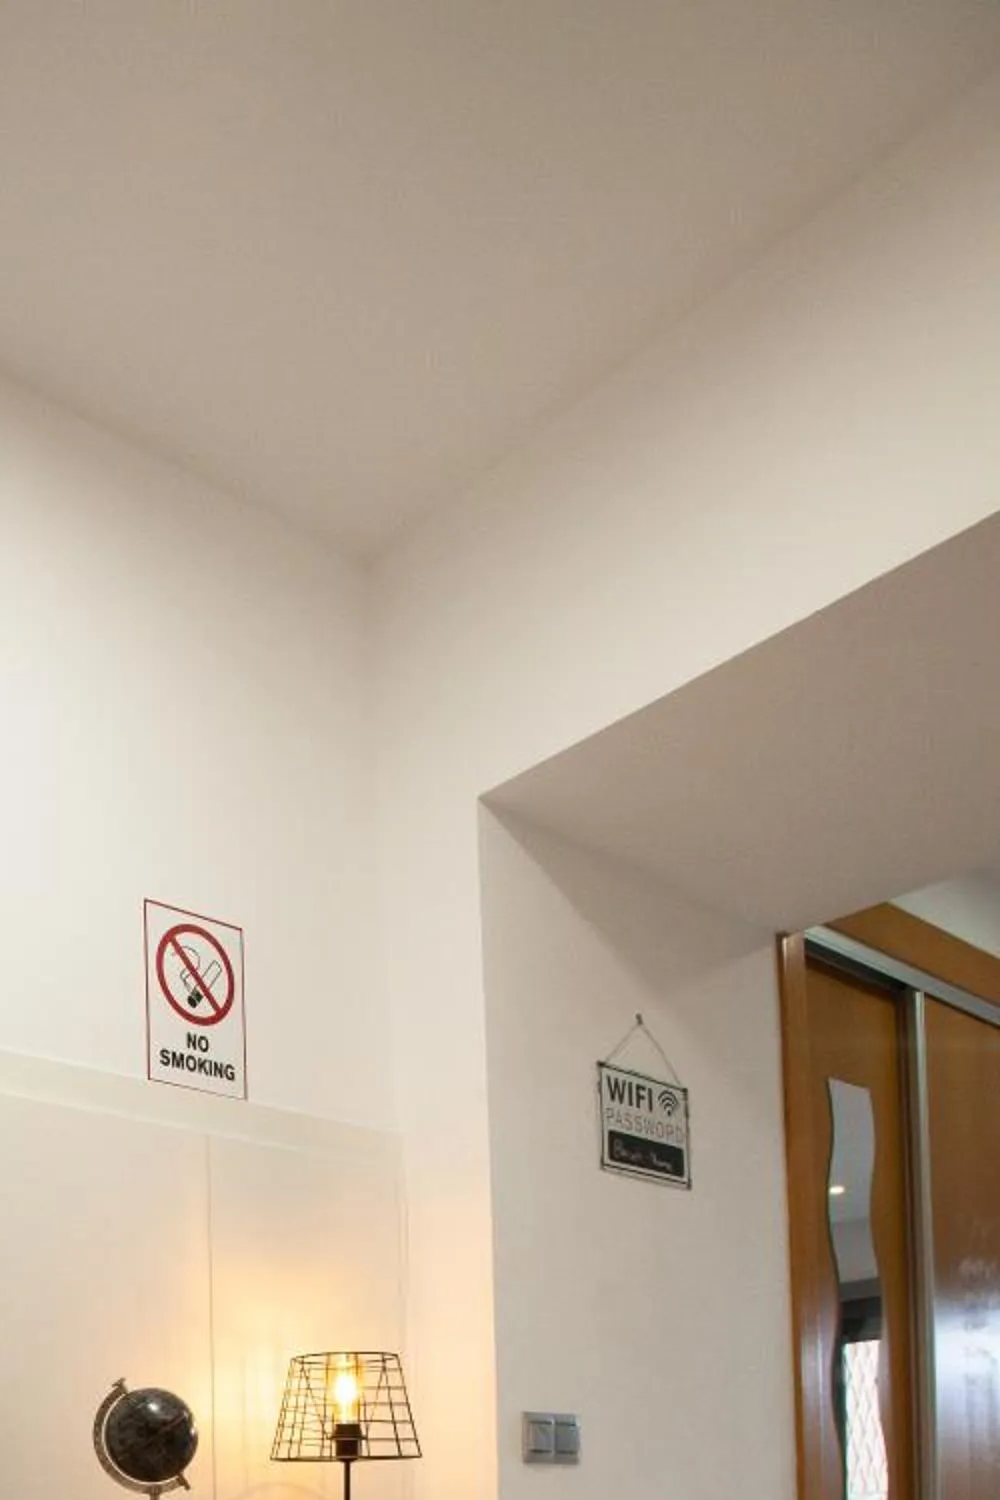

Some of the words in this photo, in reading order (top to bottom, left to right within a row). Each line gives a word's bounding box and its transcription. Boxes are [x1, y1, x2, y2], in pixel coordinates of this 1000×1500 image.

[186, 1032, 209, 1053] NO
[159, 1049, 235, 1081] SMOKING
[606, 1074, 653, 1113] WIFI
